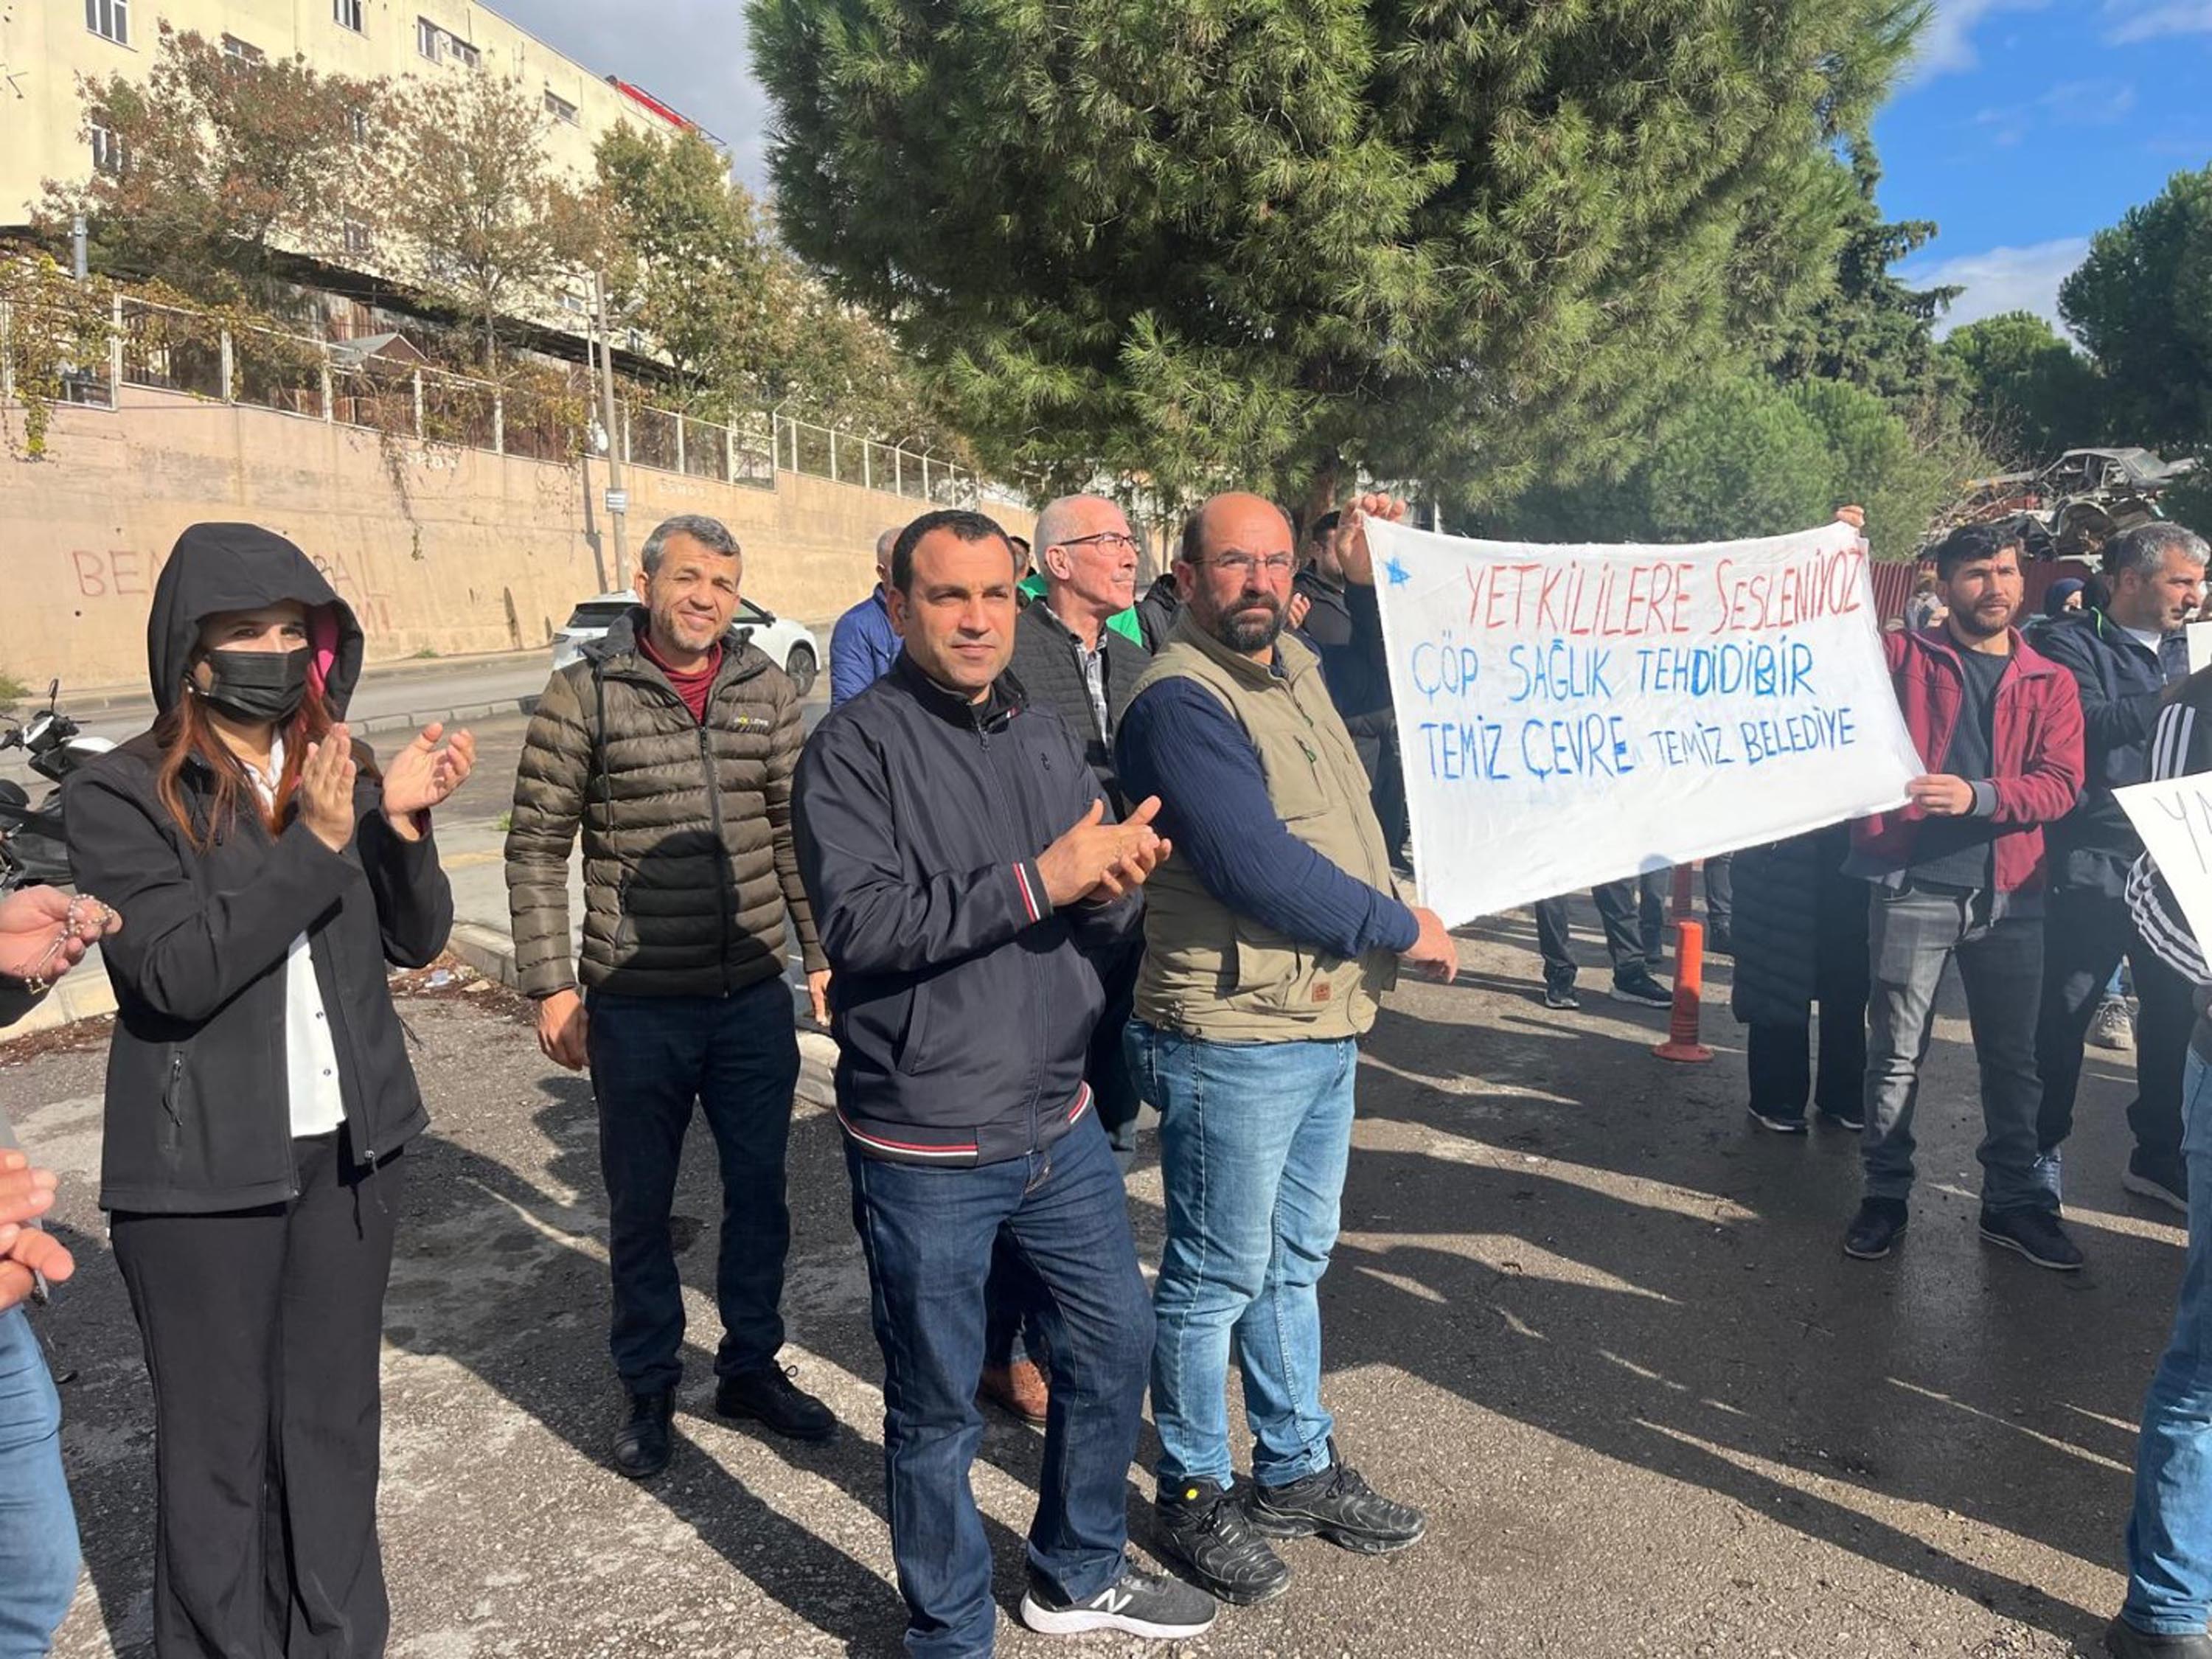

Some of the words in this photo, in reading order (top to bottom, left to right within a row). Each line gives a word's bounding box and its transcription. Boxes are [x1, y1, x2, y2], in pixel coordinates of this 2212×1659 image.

[1466, 560, 1694, 636] YETKİLİLERE
[1412, 630, 1478, 703] ÇÖP
[1509, 639, 1613, 701] SAĞLIK
[1420, 714, 1510, 779] TEMİZ
[1521, 713, 1634, 782] ÇEVRE
[1648, 720, 1734, 765] TEMİZ
[1740, 705, 1855, 765] BELEDİYE
